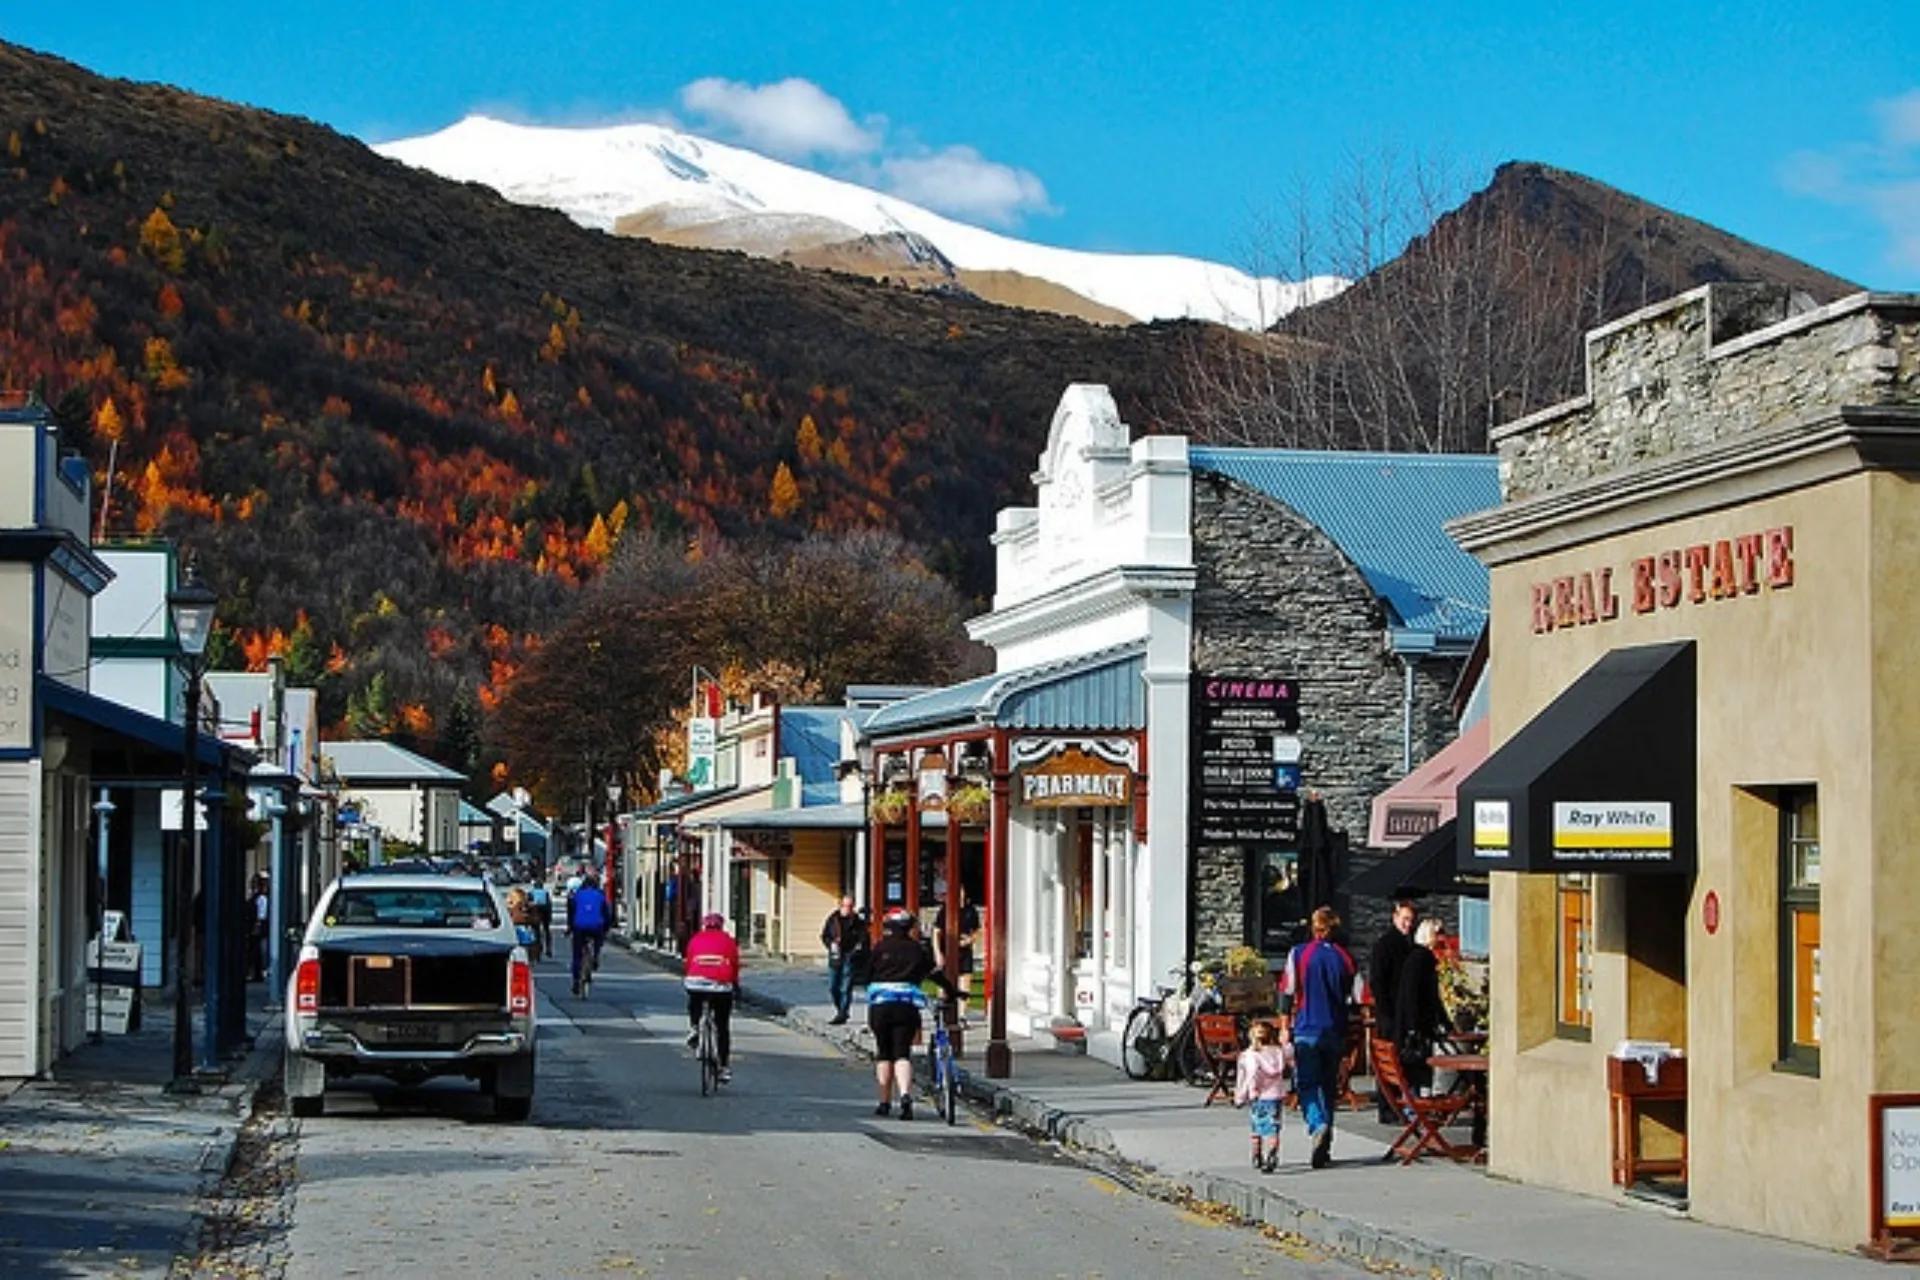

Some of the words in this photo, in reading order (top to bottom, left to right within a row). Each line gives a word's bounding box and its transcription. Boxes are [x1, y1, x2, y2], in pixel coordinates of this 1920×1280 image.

[1532, 567, 1618, 634] REAL
[1632, 526, 1793, 614] ESTATE
[1206, 681, 1289, 698] CINEMA
[1023, 773, 1126, 800] PHARMACY
[1567, 809, 1604, 828] Ray
[1606, 809, 1656, 826] White
